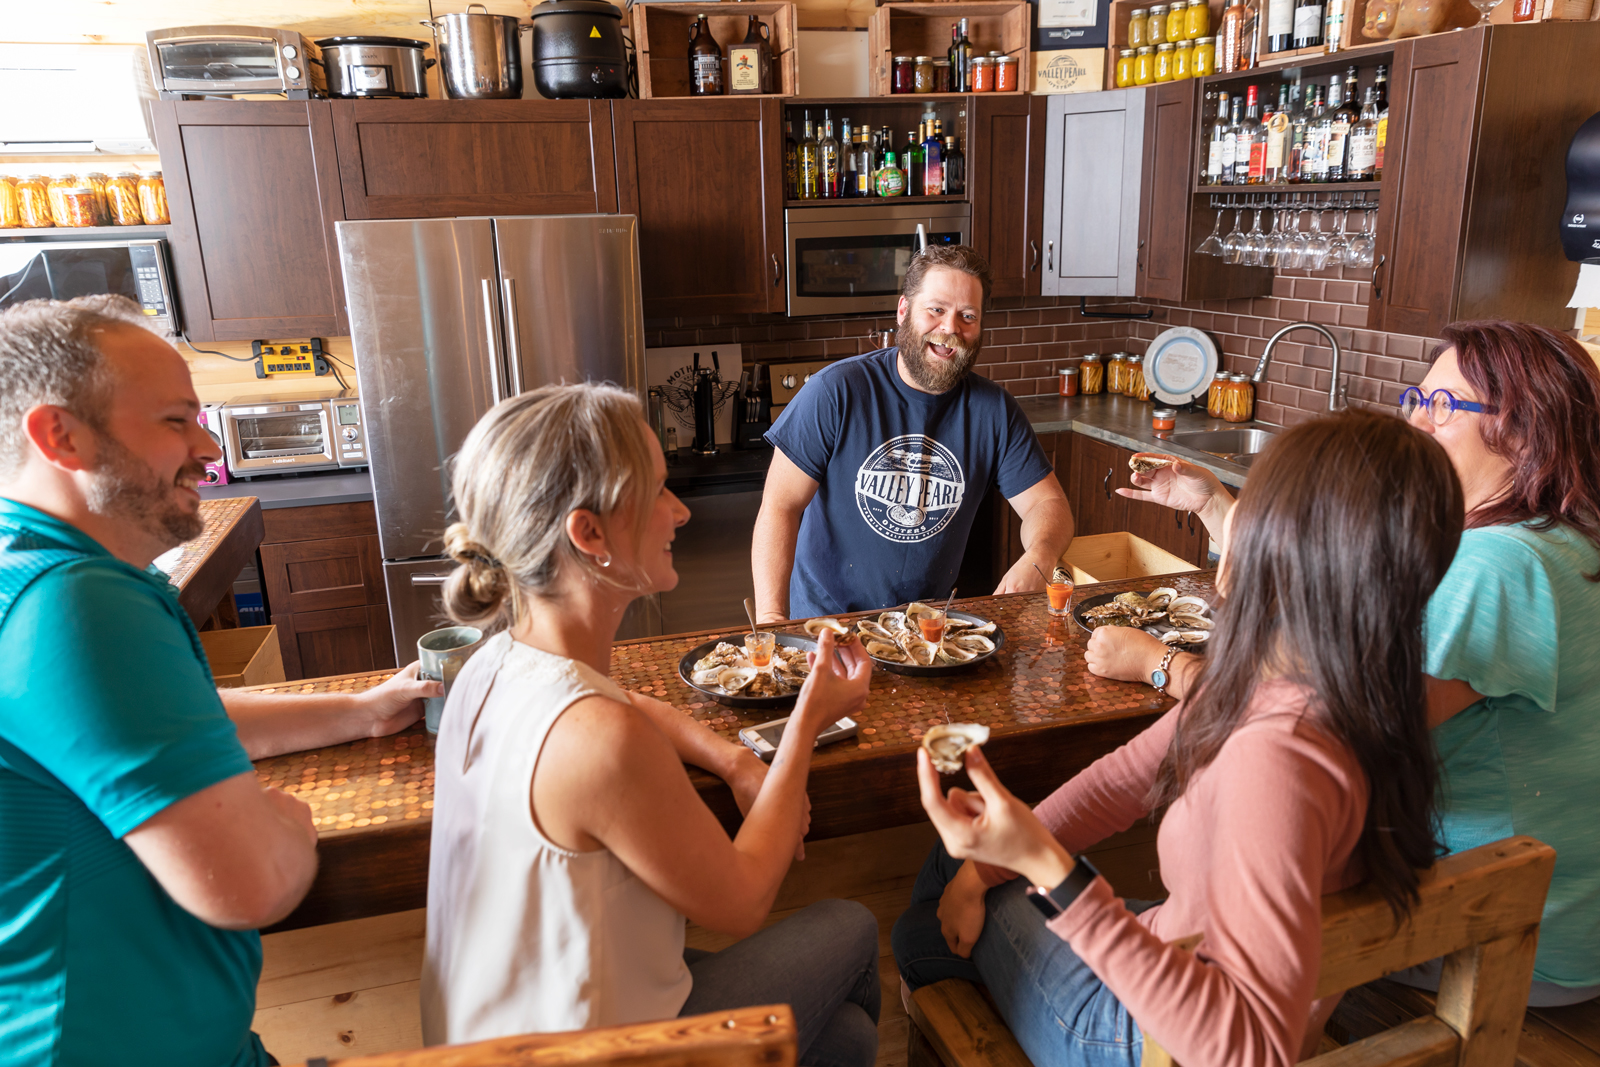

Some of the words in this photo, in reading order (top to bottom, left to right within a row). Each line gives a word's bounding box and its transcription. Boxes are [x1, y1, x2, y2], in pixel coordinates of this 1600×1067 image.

[1038, 67, 1063, 78] VALLEY
[1064, 66, 1086, 78] PEARL
[666, 364, 692, 385] MOTH
[860, 472, 916, 504] VALLEY
[917, 478, 960, 508] PEARL
[882, 519, 926, 534] OYSTERS
